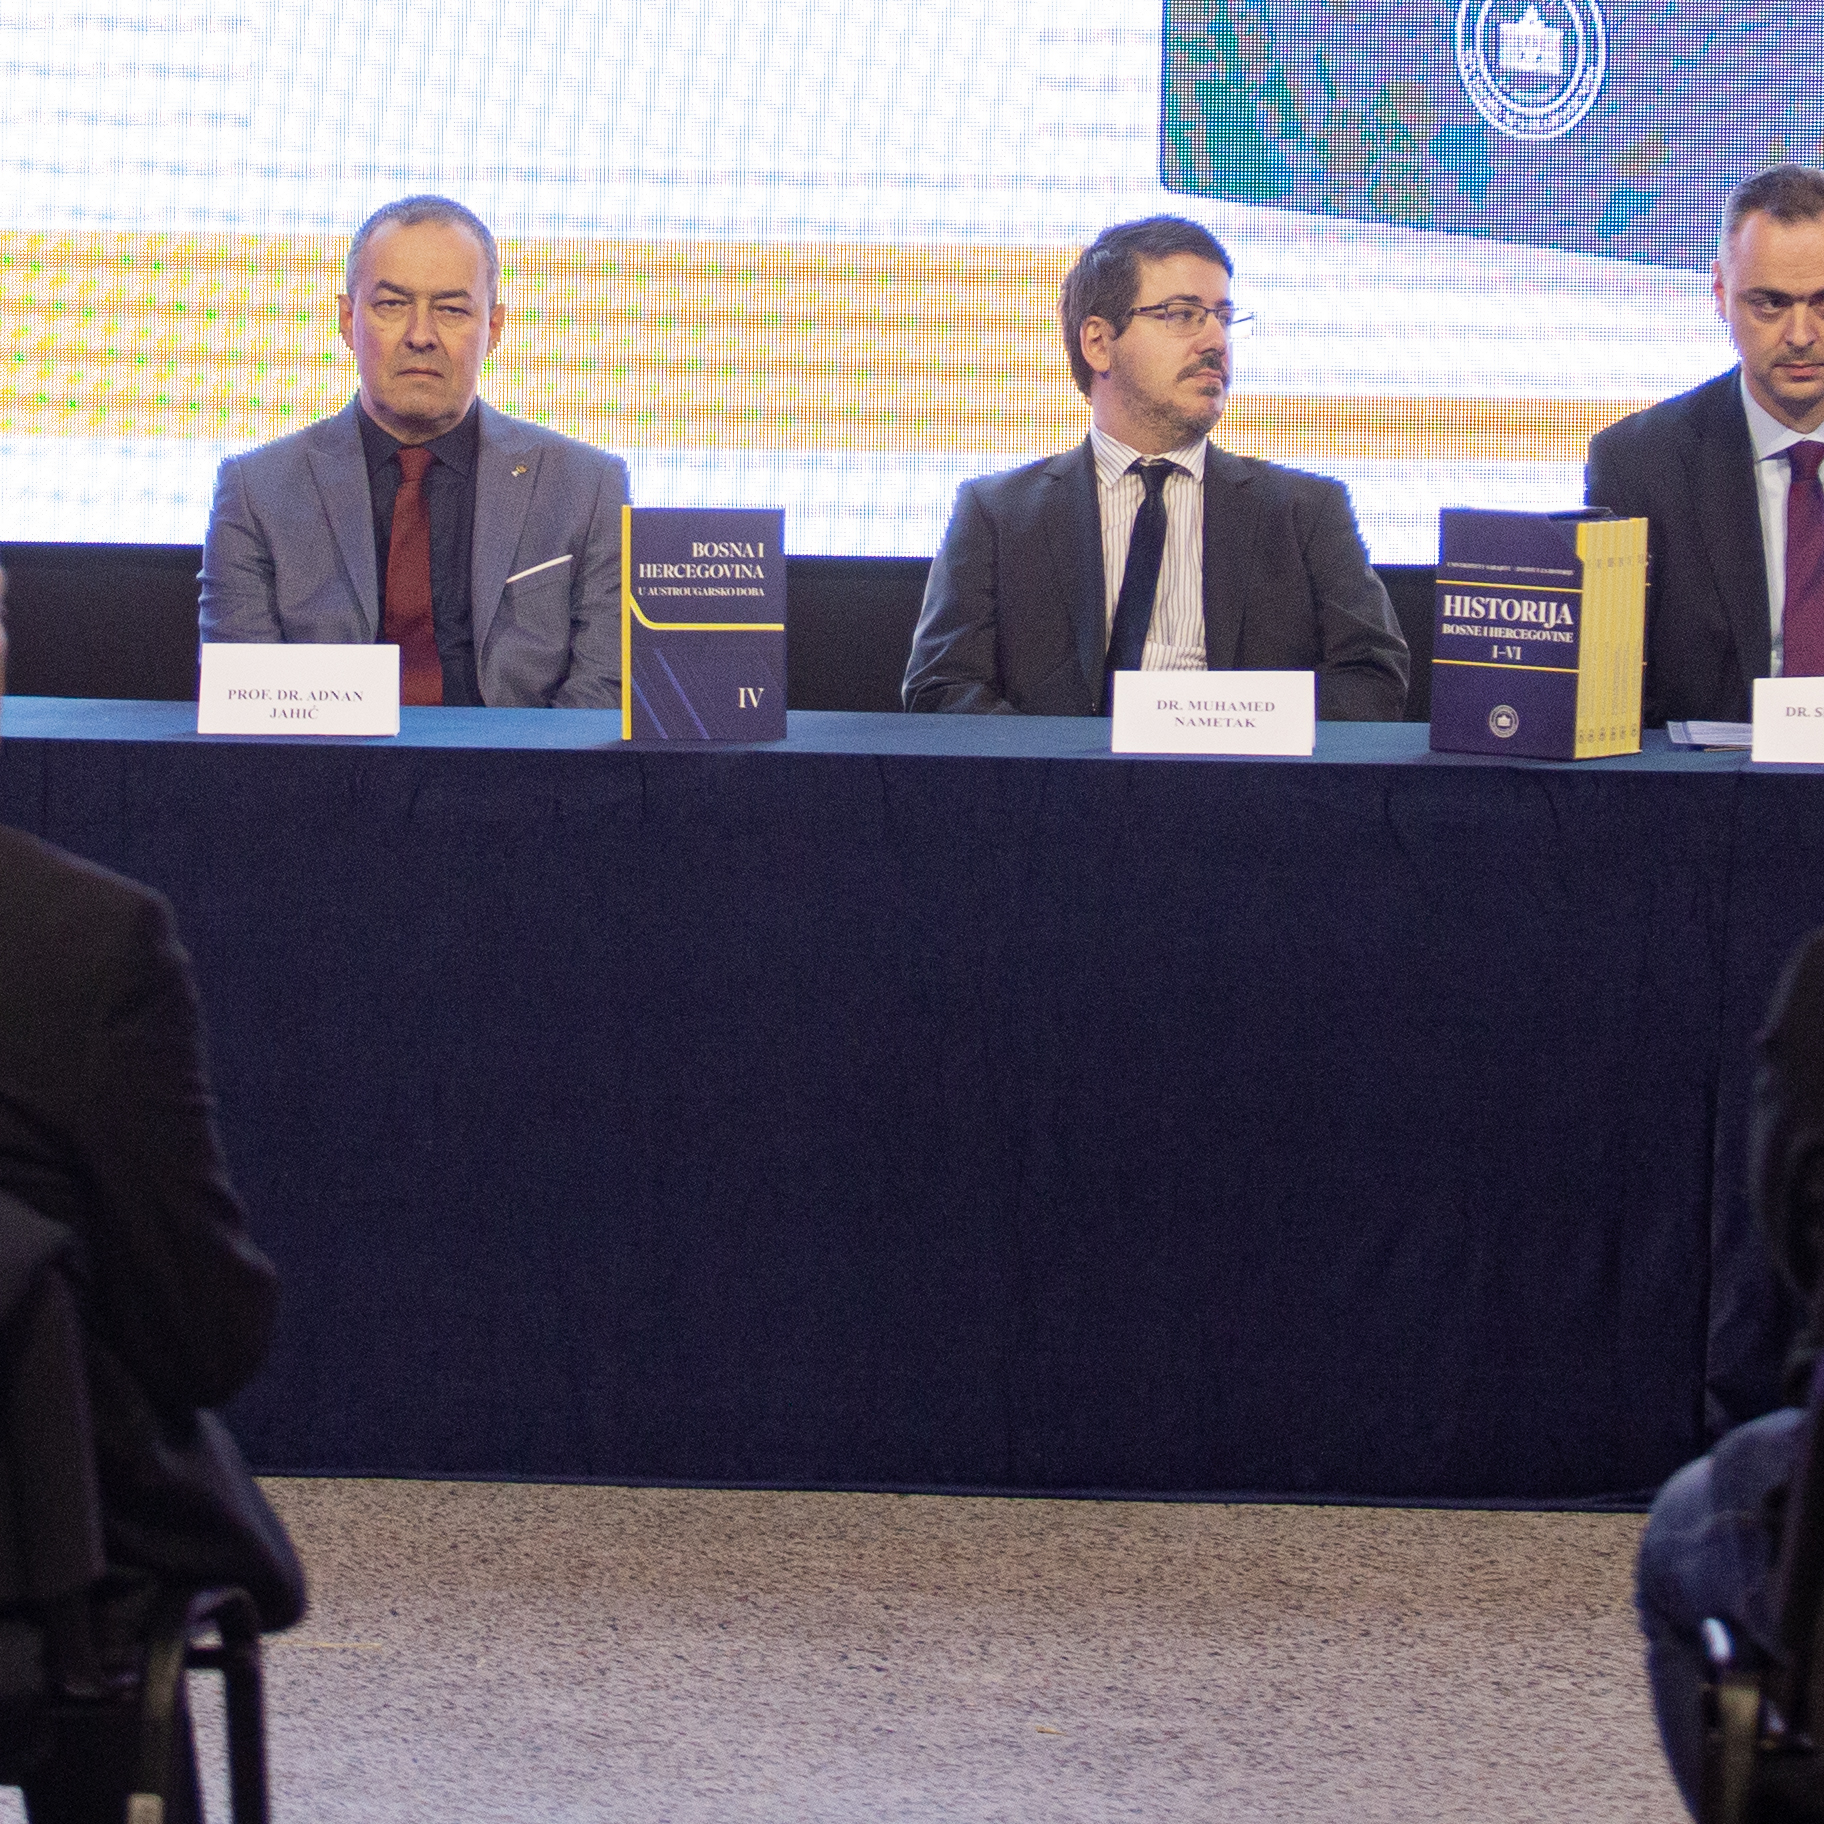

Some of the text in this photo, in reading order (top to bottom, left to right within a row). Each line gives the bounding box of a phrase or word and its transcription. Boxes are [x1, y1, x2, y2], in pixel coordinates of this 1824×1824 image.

[692, 542, 765, 558] BOSNA I
[638, 563, 765, 580] HERCEGOVINA
[637, 586, 647, 596] U
[736, 586, 765, 597] DOBA
[1443, 594, 1574, 629] HISTORIJA
[1441, 622, 1482, 637] BOSNE
[1488, 626, 1574, 643] HERCEGOVINE
[227, 688, 364, 702] PROF. DR. ADNAN
[738, 687, 765, 708] IV
[269, 704, 320, 720] JAHIĆ
[1156, 699, 1276, 712] DR. MUHAMED
[1785, 706, 1811, 717] DR.
[1175, 716, 1257, 728] NAMETAK
